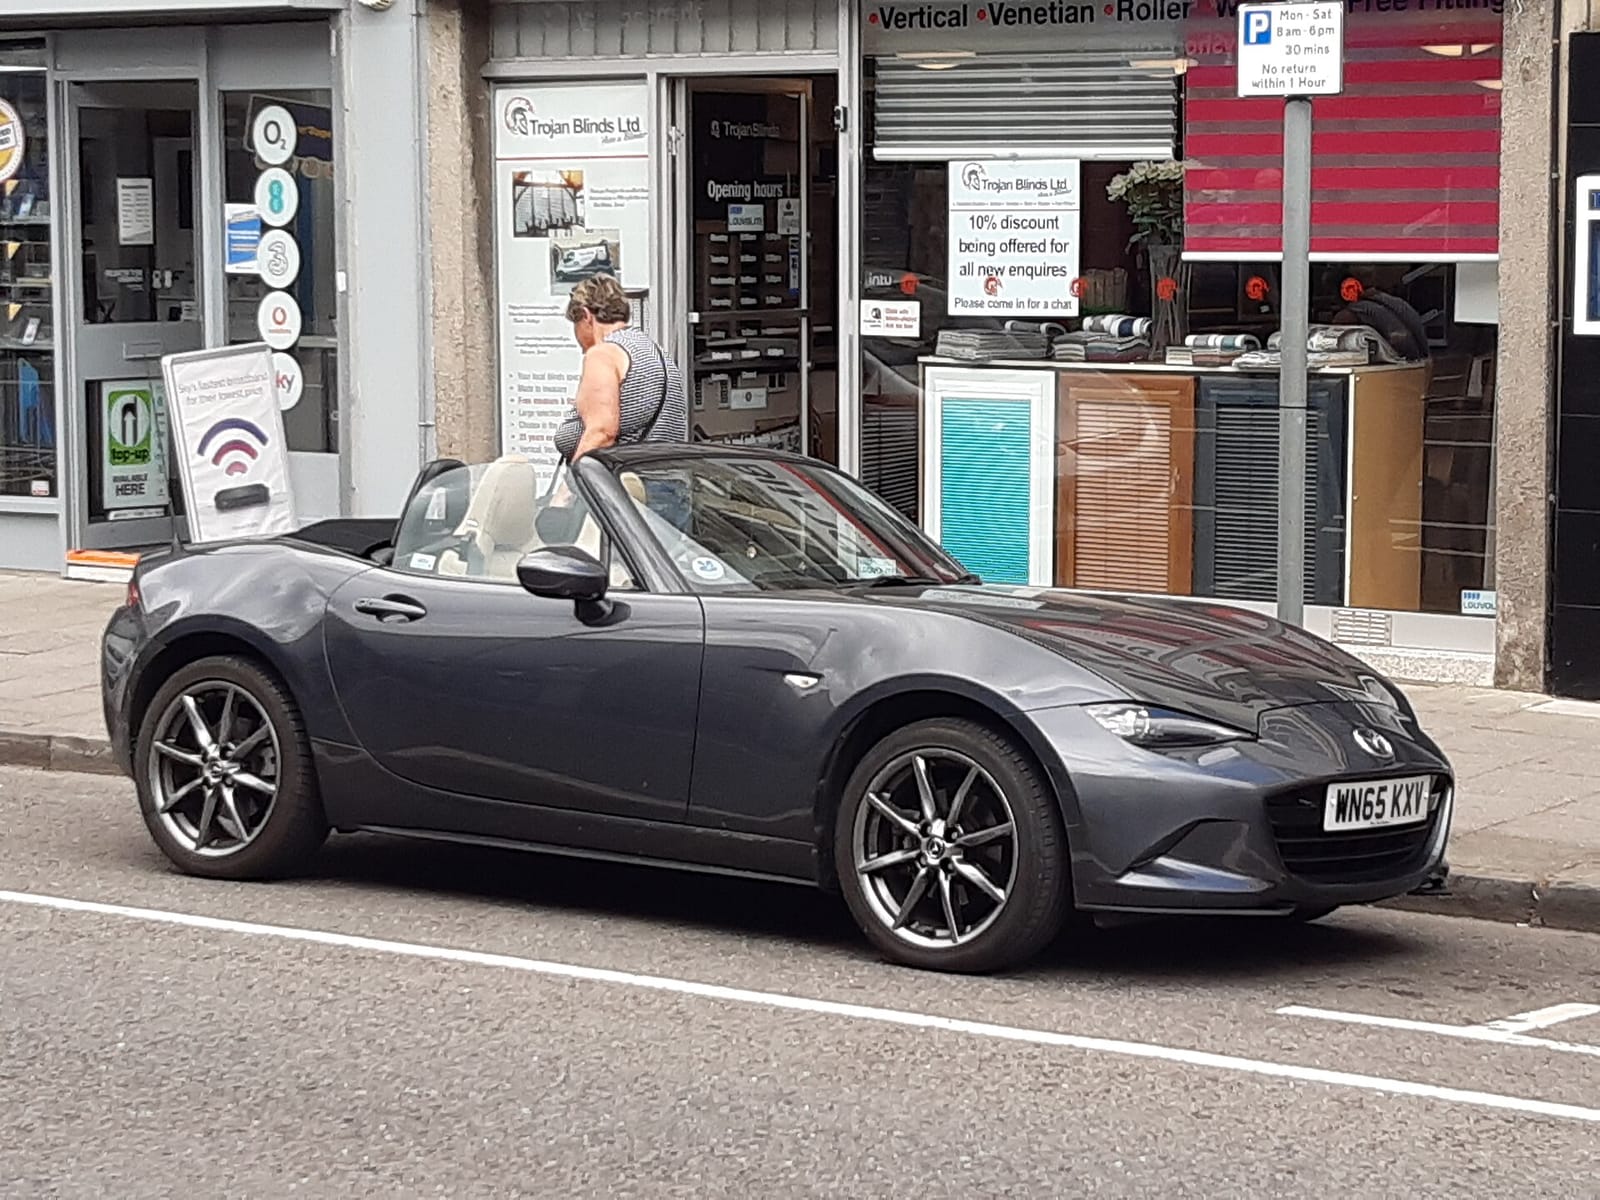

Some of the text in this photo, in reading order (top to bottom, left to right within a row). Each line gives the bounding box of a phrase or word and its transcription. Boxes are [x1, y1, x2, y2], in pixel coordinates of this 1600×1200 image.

[880, 4, 967, 29] Vertical
[988, 1, 1094, 26] Venetian
[1116, 0, 1190, 22] Roller
[1280, 10, 1303, 20] Mon
[1313, 8, 1332, 20] Sat
[1249, 13, 1269, 43] P
[1285, 44, 1330, 55] 30 mins
[1262, 64, 1316, 74] No return
[1252, 77, 1285, 88] within
[1299, 77, 1326, 88] Hour
[530, 116, 640, 139] Trojan Blinds Ltd
[707, 180, 783, 201] Opening hours
[981, 178, 1067, 194] Trojan Blinds Ltd
[969, 214, 1059, 230] 10% discount
[959, 238, 1069, 256] being offered for
[869, 272, 892, 286] intu
[959, 262, 1067, 280] all new enquires
[954, 297, 1072, 310] Please come in for a chat
[275, 369, 295, 393] ky
[111, 448, 149, 462] top-up
[115, 482, 145, 497] HERE
[1335, 781, 1424, 823] WN65 KXV
